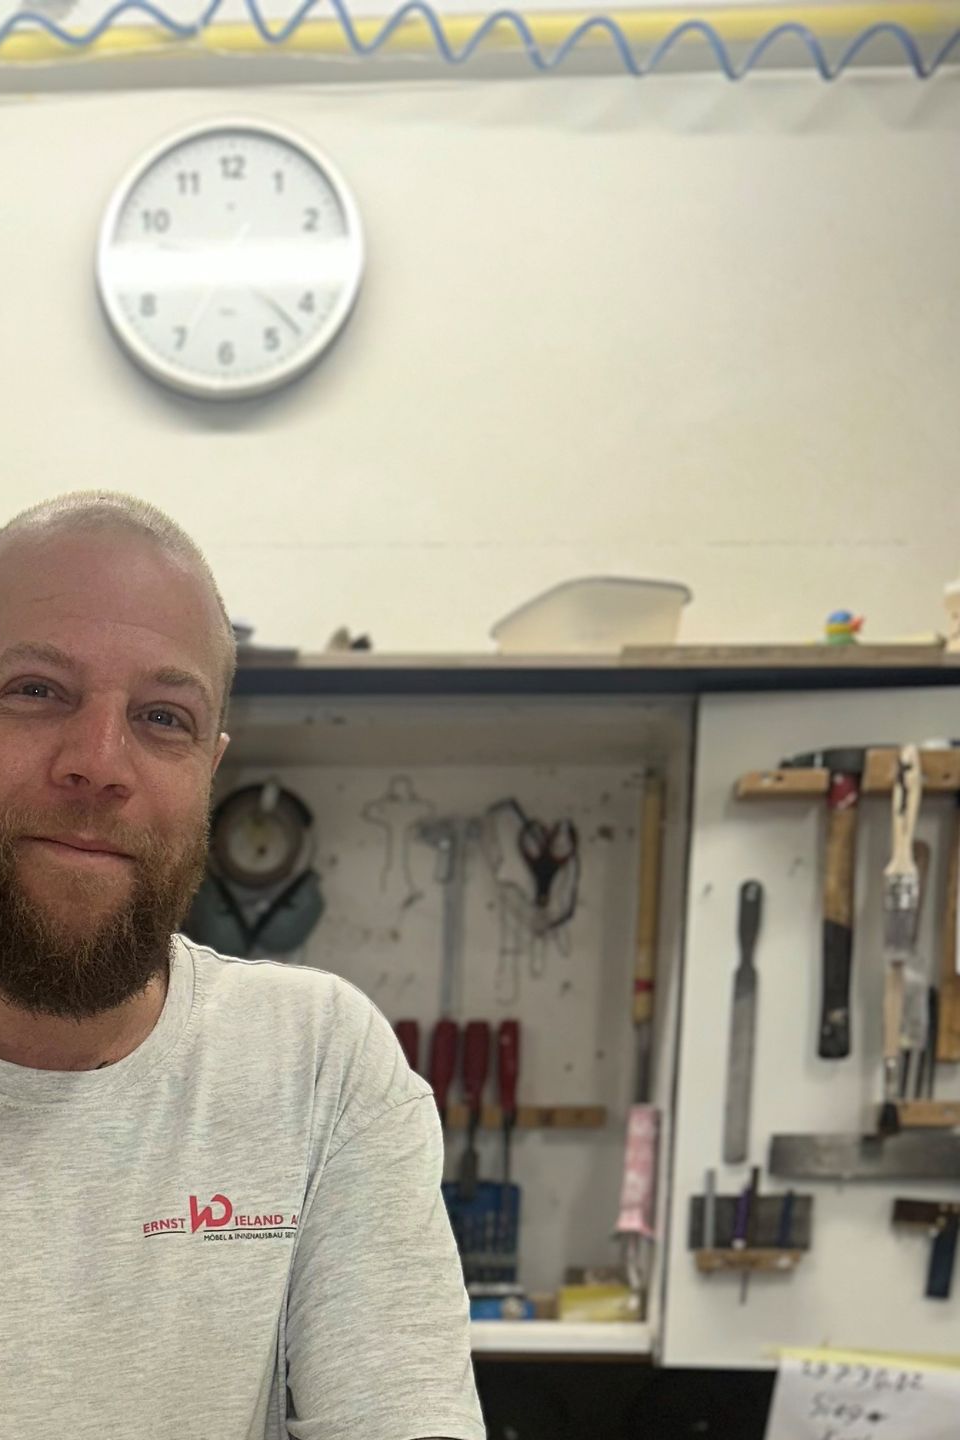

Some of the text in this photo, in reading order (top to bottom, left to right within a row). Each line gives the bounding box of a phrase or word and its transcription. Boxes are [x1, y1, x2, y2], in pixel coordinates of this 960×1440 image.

[220, 155, 246, 180] 12
[177, 172, 200, 195] 11
[273, 170, 284, 193] 1
[142, 208, 171, 233] 10
[302, 207, 319, 232] 2
[139, 293, 157, 318] 8
[298, 291, 315, 314] 4
[173, 326, 187, 350] 7
[264, 327, 281, 351] 5
[217, 341, 235, 366] 6
[143, 1218, 186, 1234] ERNST
[203, 1232, 227, 1242] MÖBEL
[228, 1232, 233, 1241] &
